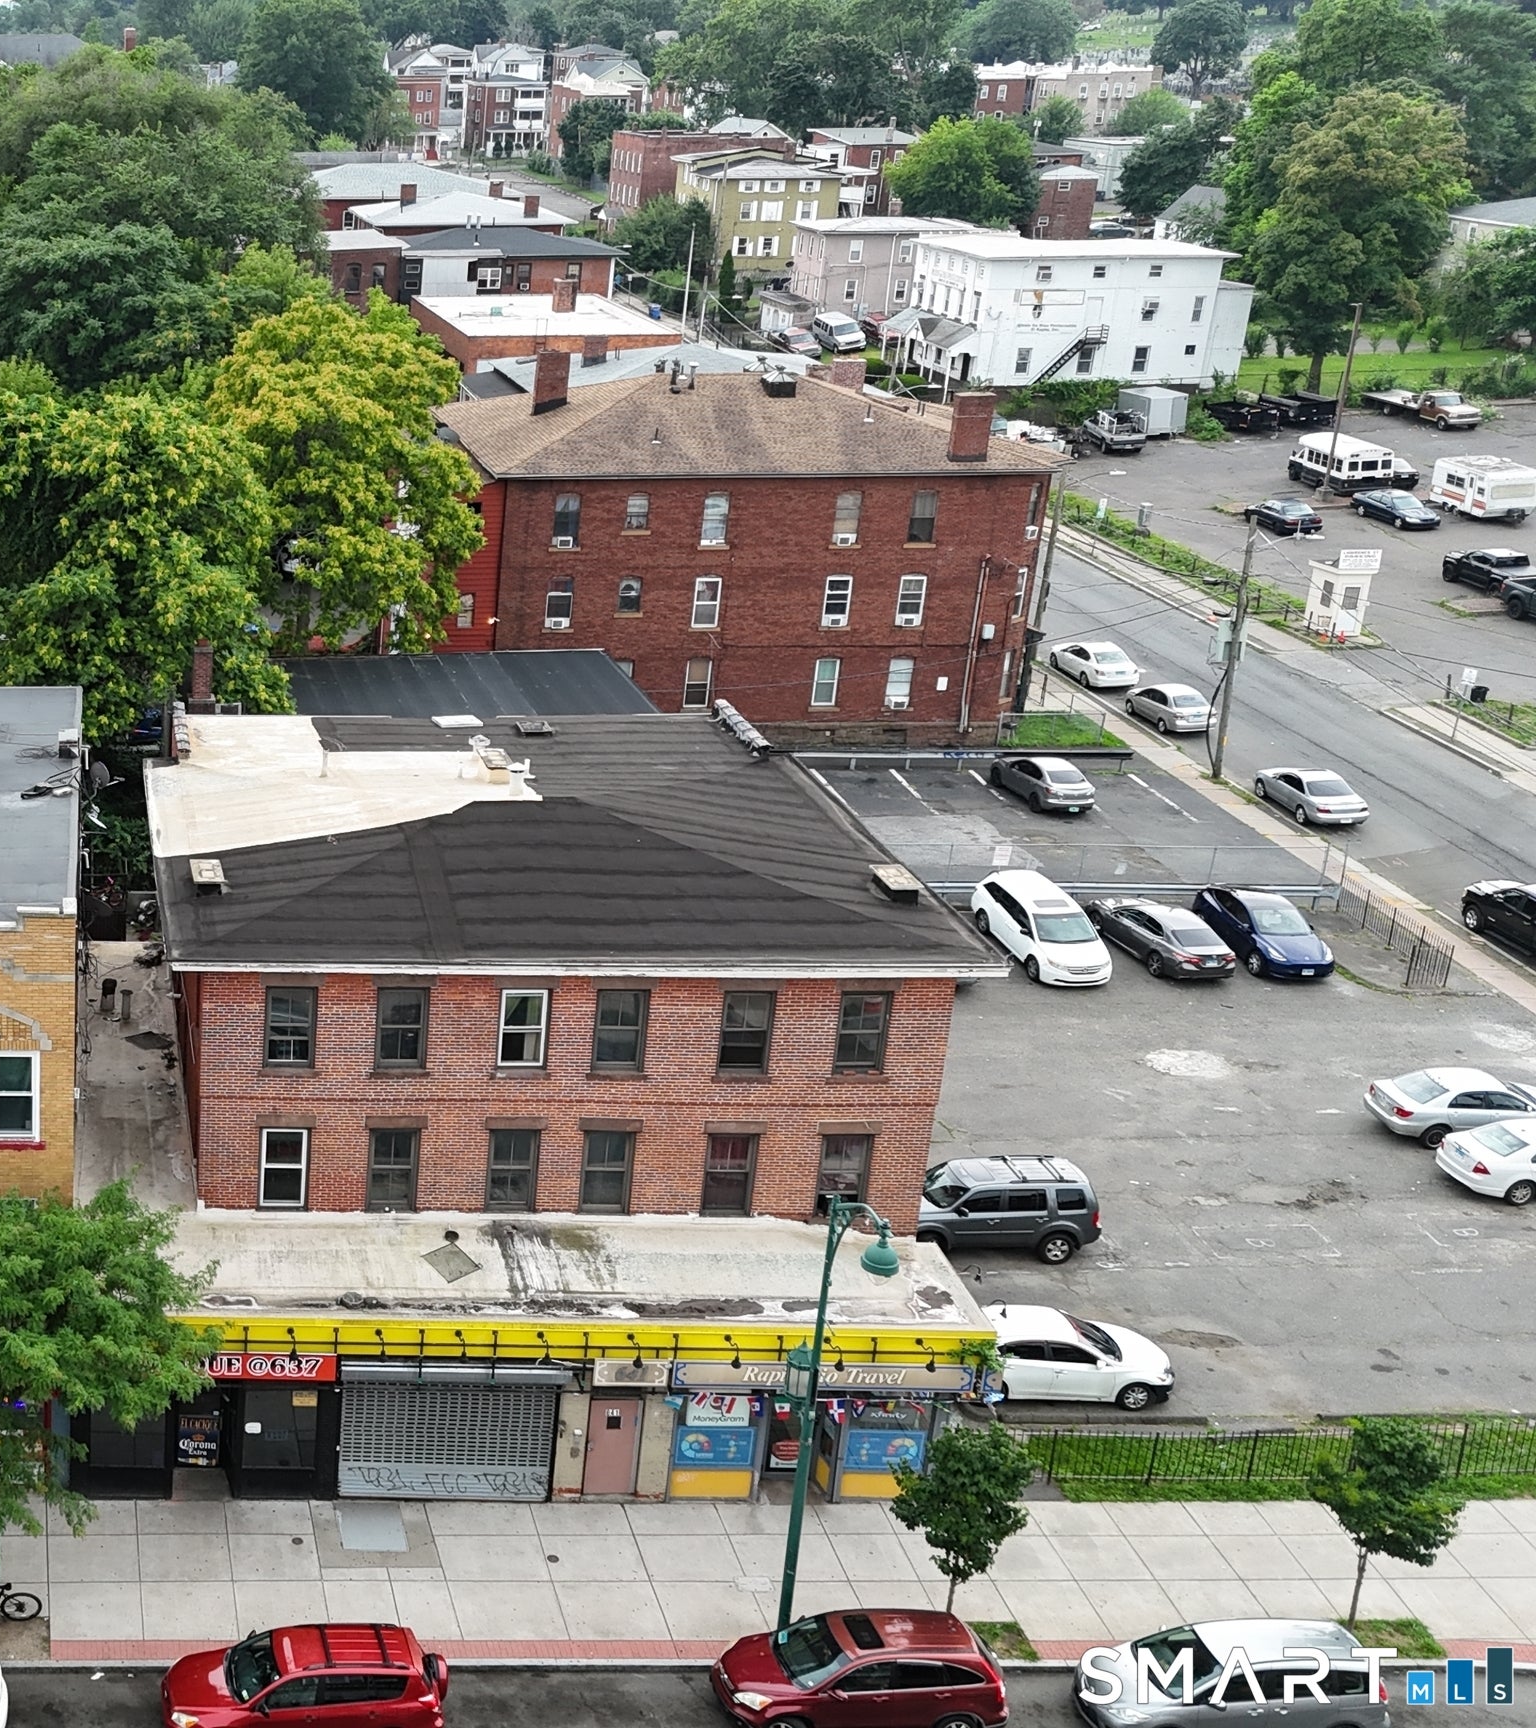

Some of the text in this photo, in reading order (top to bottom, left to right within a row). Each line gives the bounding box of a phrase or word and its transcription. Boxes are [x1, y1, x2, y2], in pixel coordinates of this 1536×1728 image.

[847, 1367, 907, 1385] Travel
[692, 1414, 745, 1424] MoneyGram
[178, 1438, 217, 1450] Corona
[188, 1448, 208, 1456] Extra
